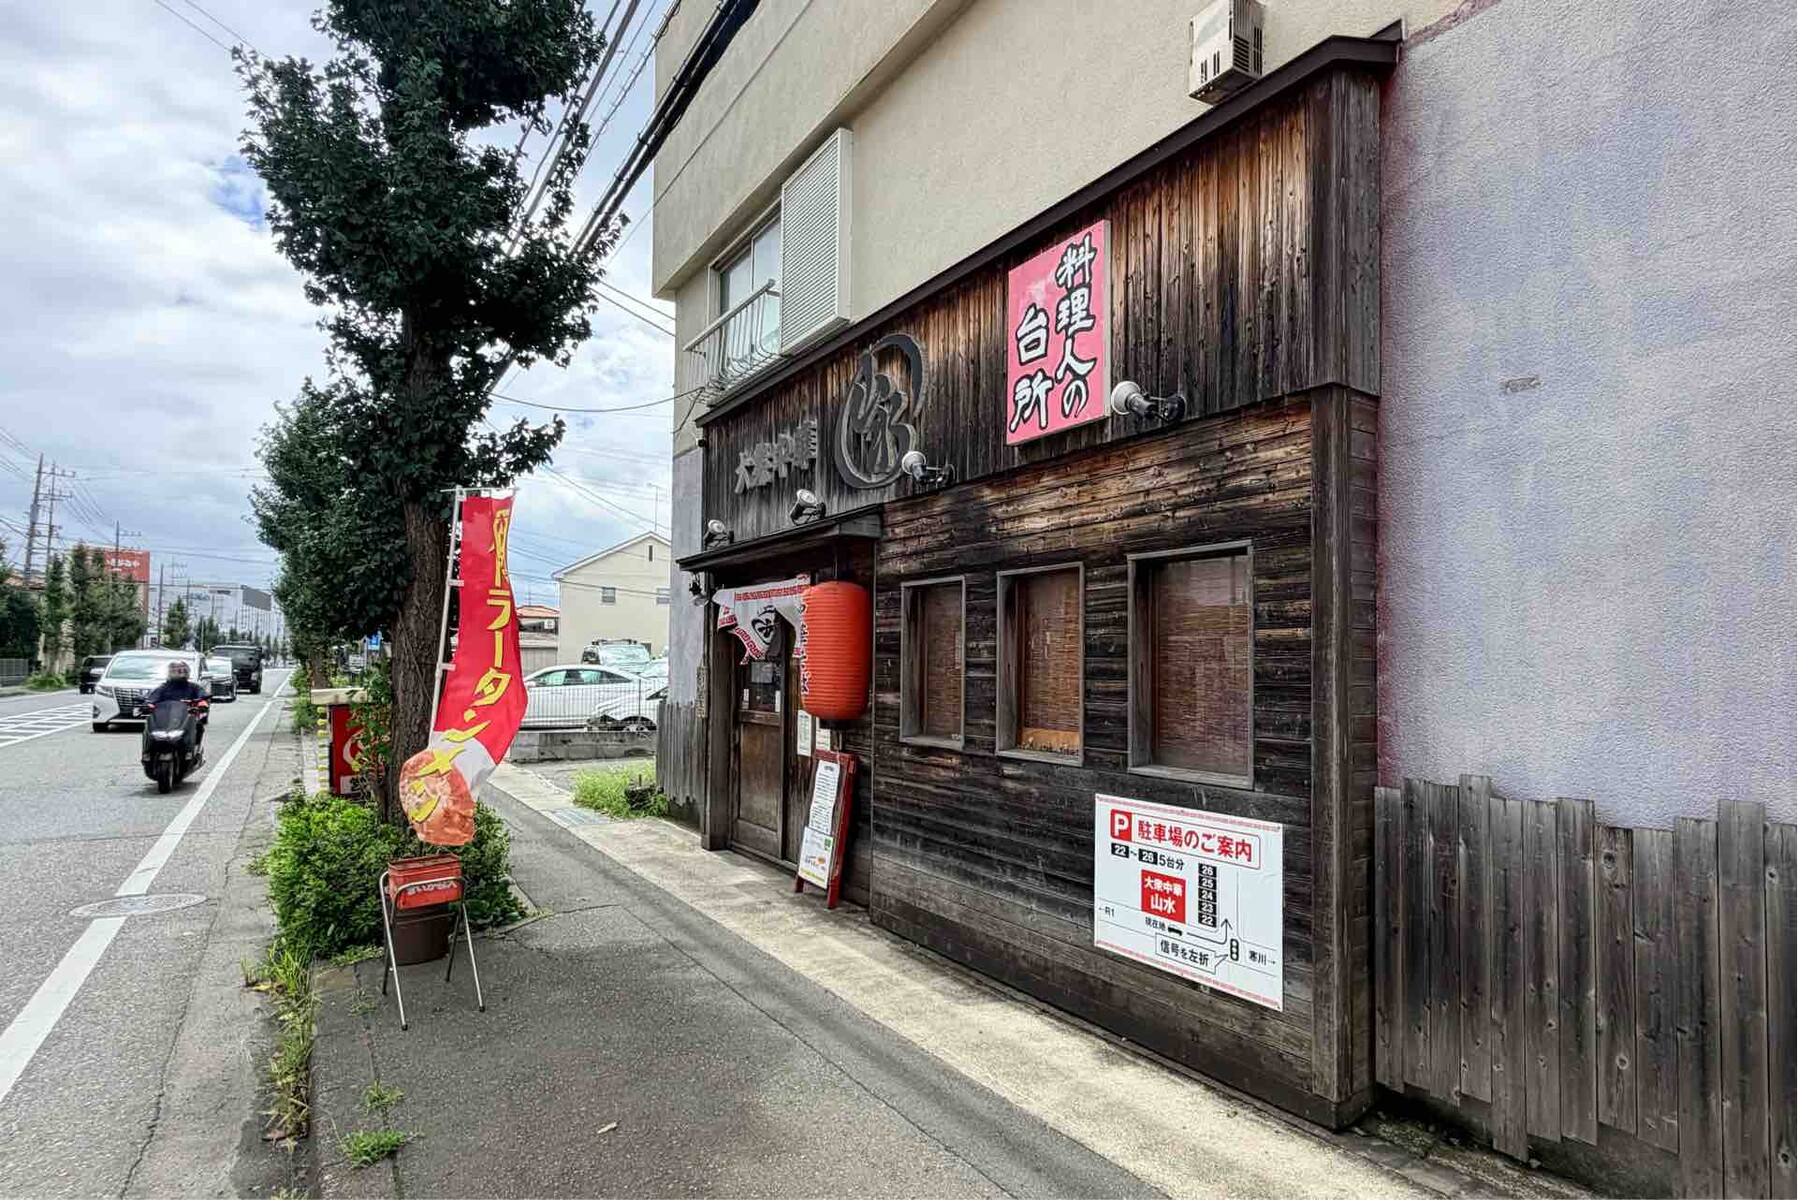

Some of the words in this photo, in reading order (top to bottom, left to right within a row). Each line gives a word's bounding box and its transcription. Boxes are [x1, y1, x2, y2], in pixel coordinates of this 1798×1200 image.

[1056, 233, 1097, 418] 料理人の
[1009, 304, 1053, 432] 台所
[1114, 813, 1129, 837] P
[1138, 819, 1252, 862] 駐車場のご案内
[1201, 865, 1214, 876] 26
[1201, 878, 1214, 888] 25
[1150, 893, 1176, 914] 山水
[1201, 890, 1214, 901] 24
[1201, 902, 1214, 913] 23
[1201, 915, 1214, 926] 22
[1160, 939, 1209, 967] 信号を左折
